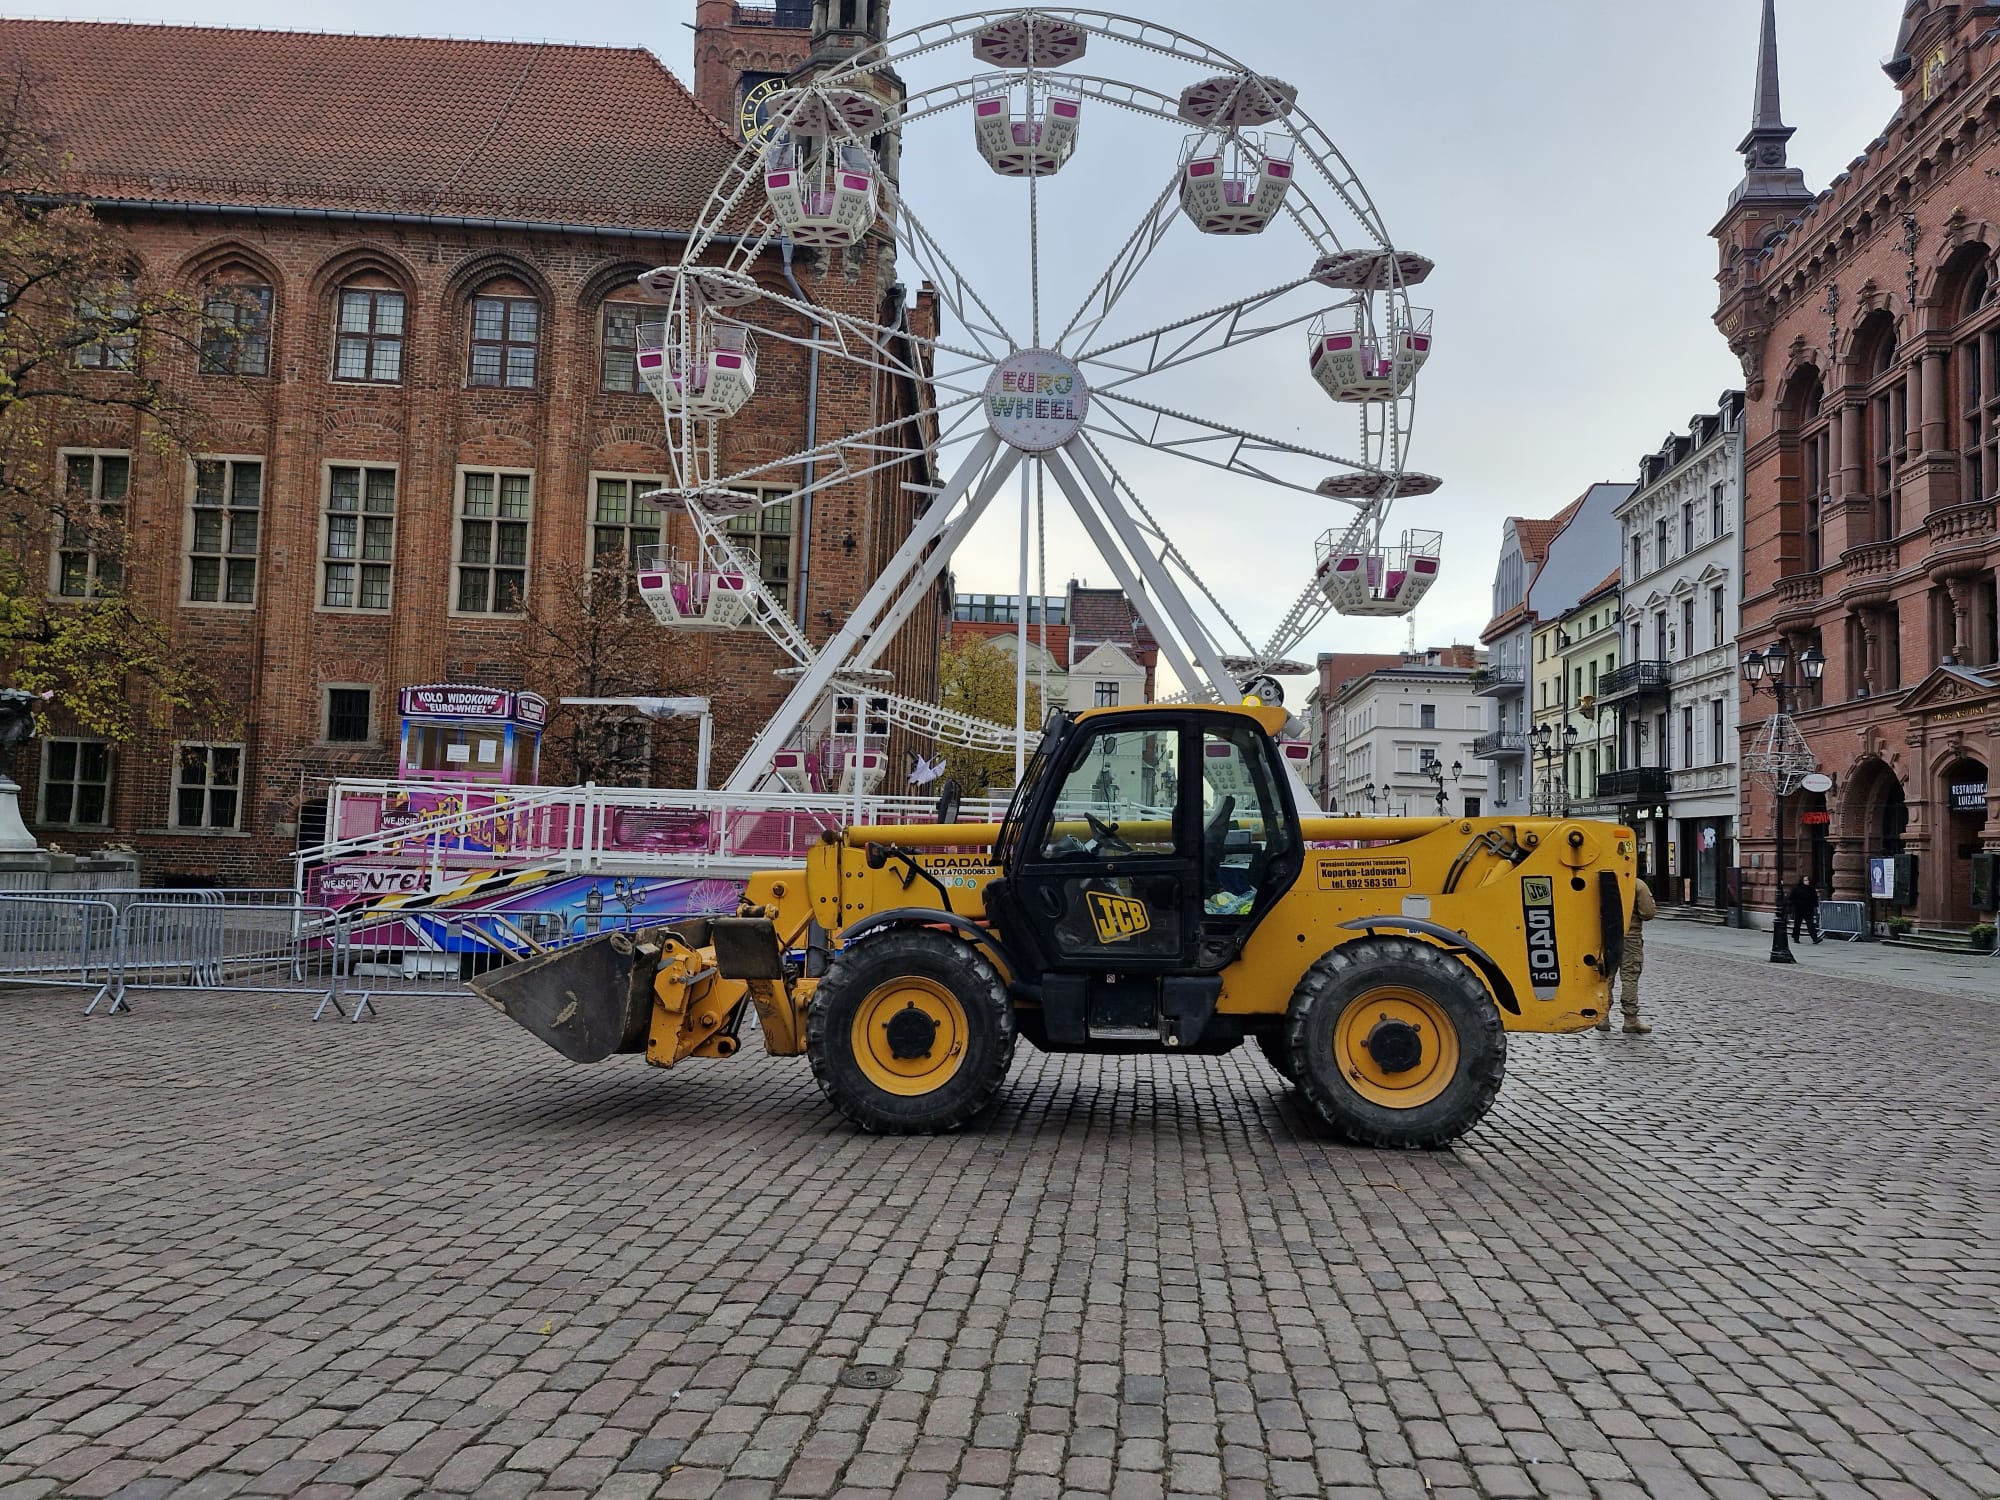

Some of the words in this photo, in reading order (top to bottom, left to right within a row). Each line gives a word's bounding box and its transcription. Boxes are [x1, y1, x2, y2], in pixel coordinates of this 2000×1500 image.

[1003, 371, 1073, 395] EURO
[990, 395, 1079, 420] WHEEL
[417, 691, 444, 704] KOŁO
[447, 692, 500, 705] WIDOKOWE
[1952, 783, 1988, 795] RESTAURACJ
[383, 814, 418, 825] WEJŚCIE
[925, 858, 993, 868] LOADAL
[323, 878, 360, 889] WEJŚCIE
[363, 872, 432, 893] NTER
[1332, 880, 1345, 889] tel.
[1346, 879, 1363, 888] 692
[1382, 878, 1397, 887] 501
[1529, 884, 1549, 900] JCB
[1098, 897, 1146, 938] JCB
[1528, 909, 1555, 969] 540
[1531, 972, 1558, 981] 140
